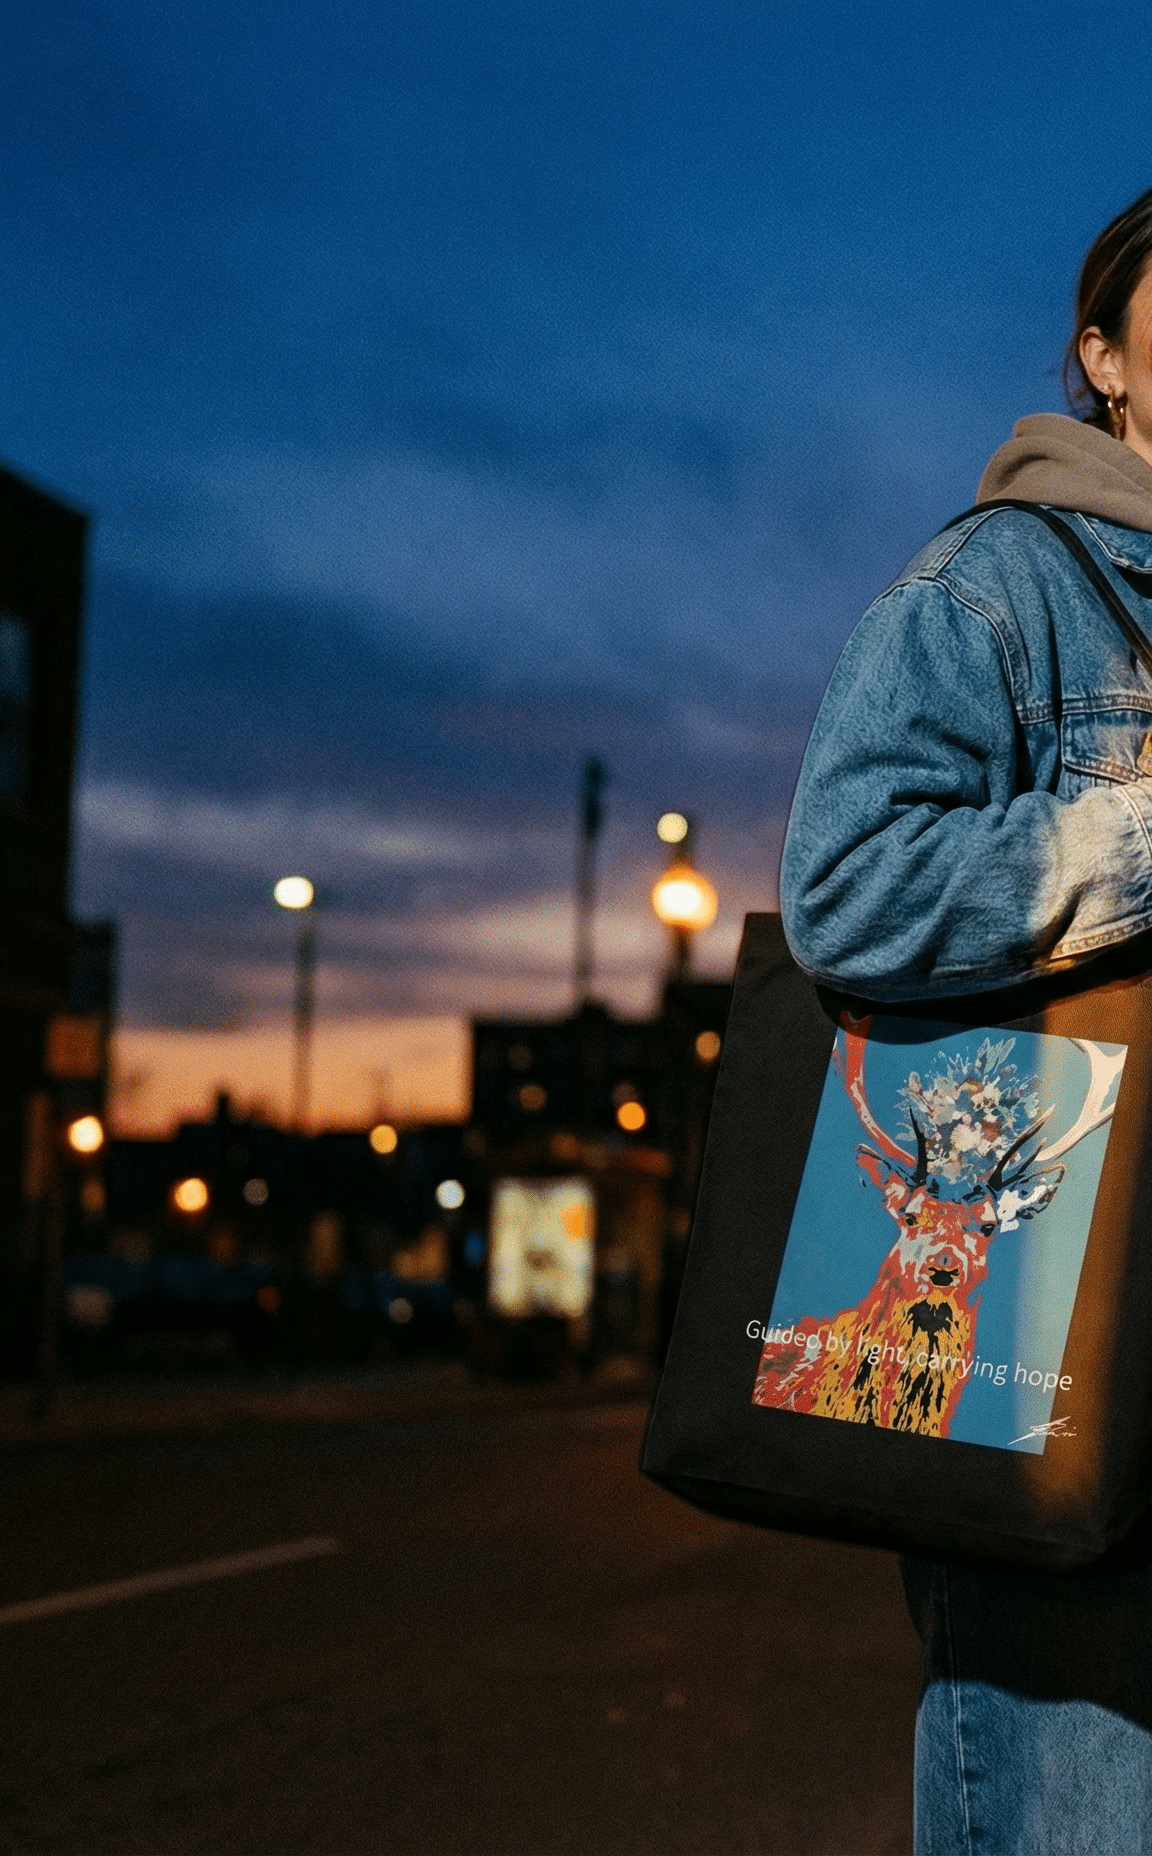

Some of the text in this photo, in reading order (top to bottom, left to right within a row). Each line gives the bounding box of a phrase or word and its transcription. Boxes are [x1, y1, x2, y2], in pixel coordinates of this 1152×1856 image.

[746, 1319, 823, 1350] Guided
[825, 1330, 853, 1359] by
[916, 1351, 1008, 1386] carrying
[1014, 1361, 1073, 1393] hope
